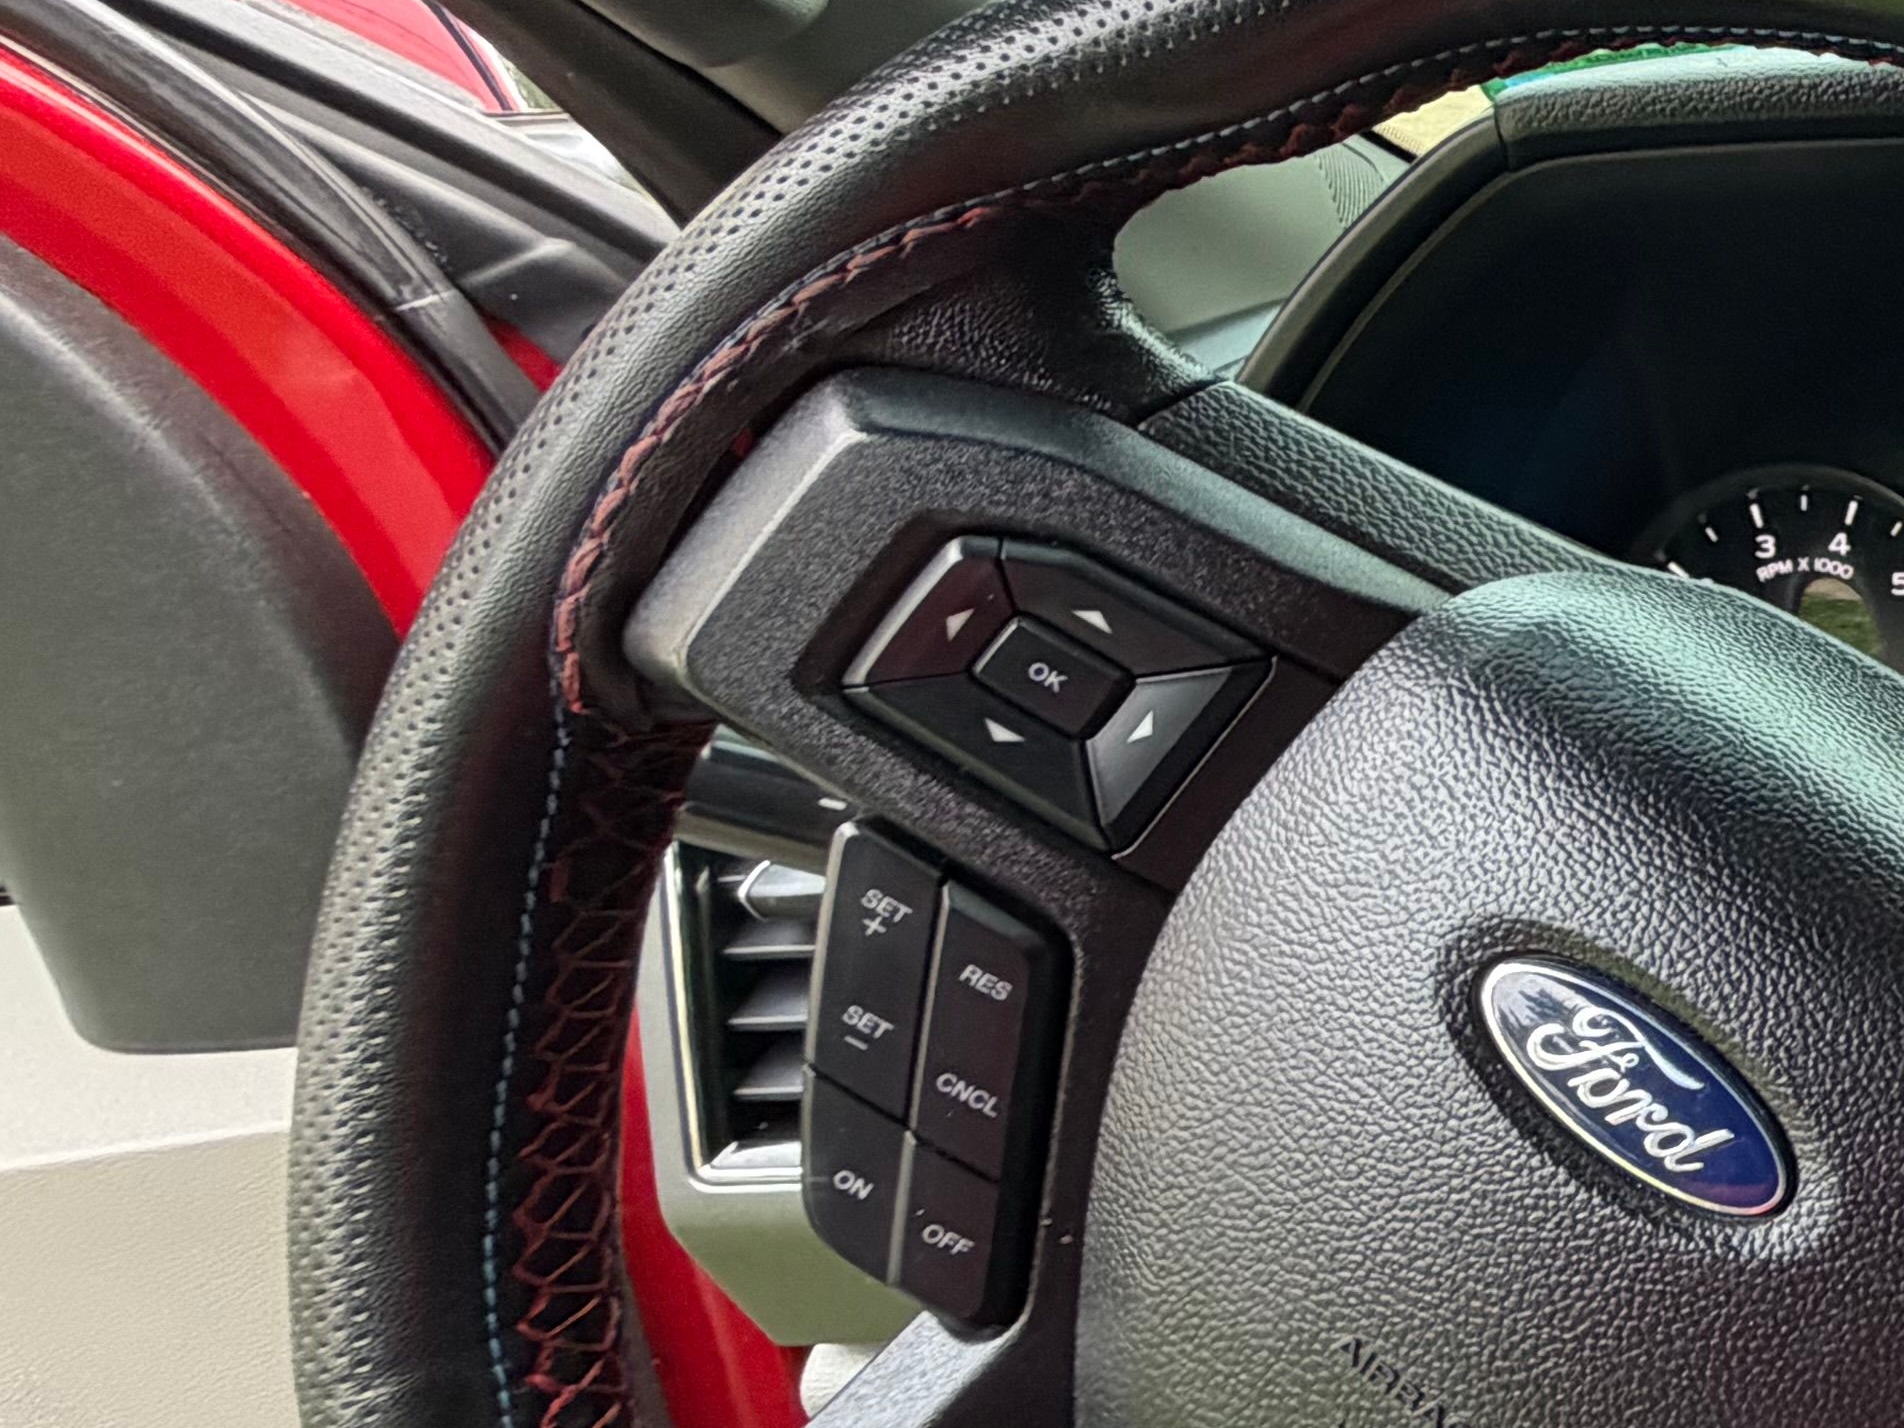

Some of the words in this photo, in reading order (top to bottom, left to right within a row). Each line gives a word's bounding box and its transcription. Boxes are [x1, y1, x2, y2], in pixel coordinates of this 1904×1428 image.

[1755, 534, 1776, 559] 3
[1828, 532, 1851, 556] 4
[1755, 558, 1793, 582] RPM
[1814, 557, 1854, 580] 1000
[1027, 659, 1071, 694] OK
[859, 886, 912, 926] SET
[959, 962, 1013, 1002] RES
[841, 1003, 894, 1043] SET
[935, 1070, 1001, 1119] CNCL
[1525, 1004, 1735, 1174] Ford
[832, 1166, 874, 1202] ON
[922, 1221, 974, 1260] OFF
